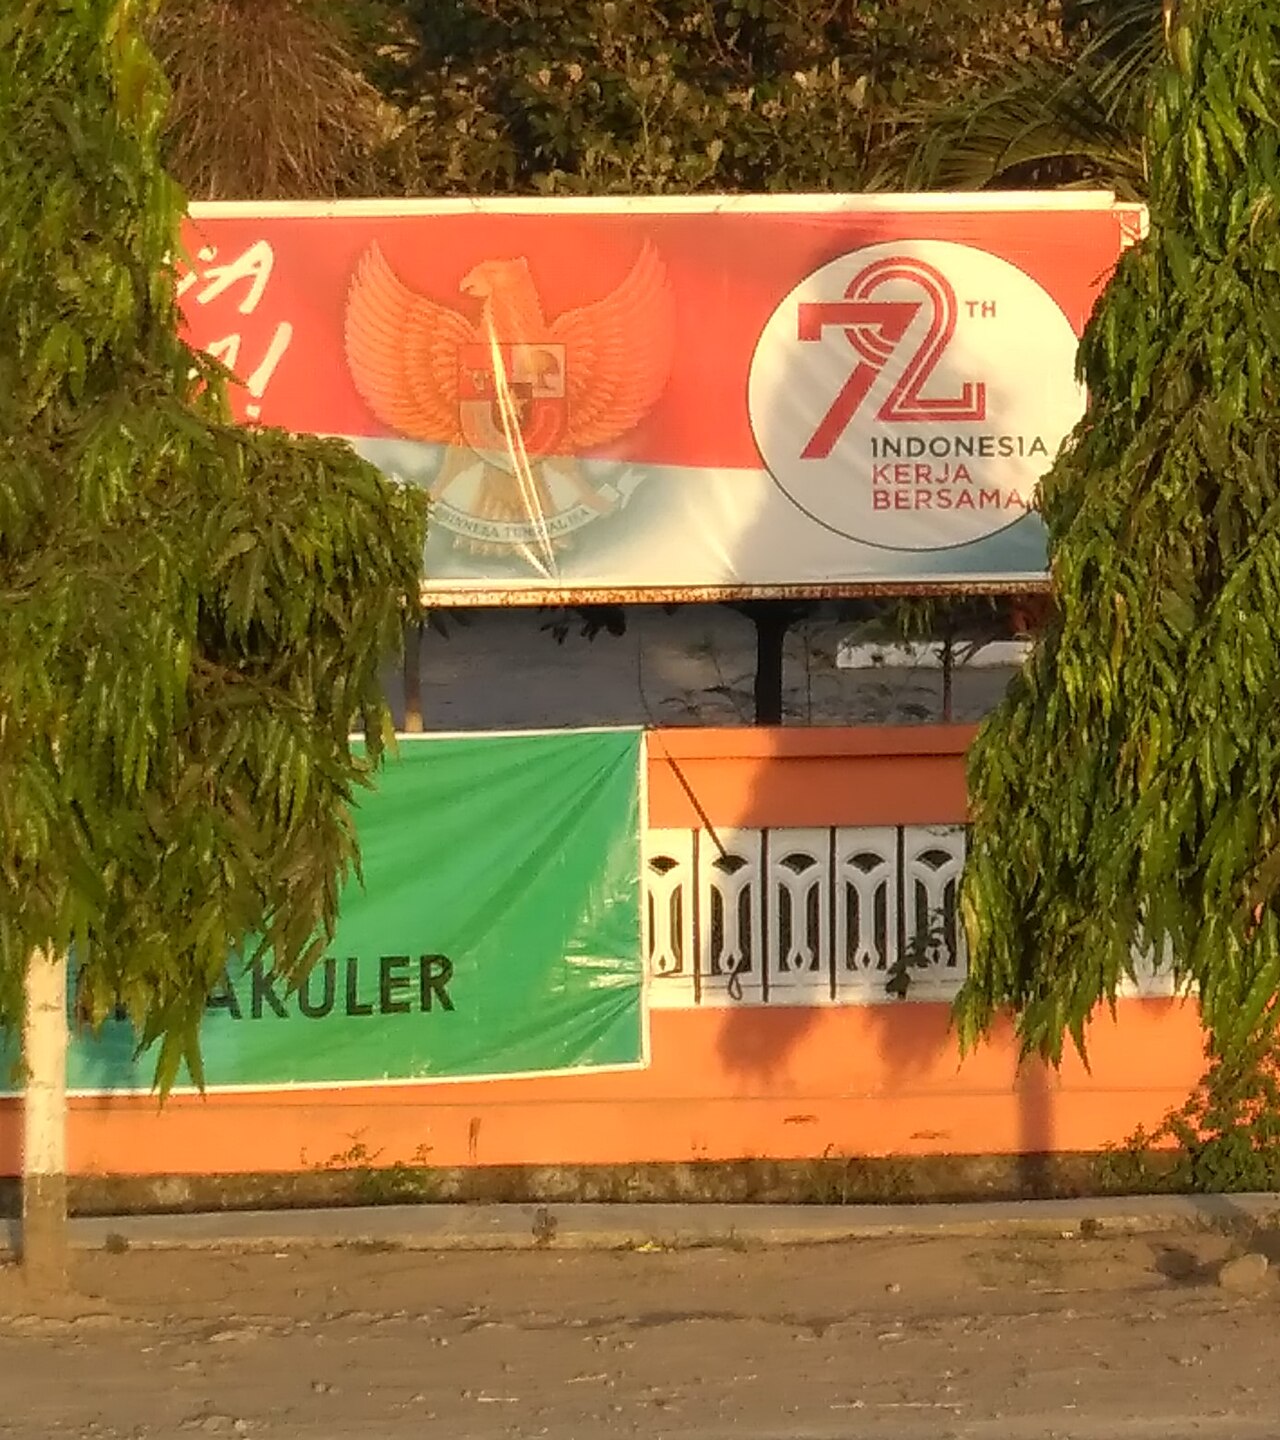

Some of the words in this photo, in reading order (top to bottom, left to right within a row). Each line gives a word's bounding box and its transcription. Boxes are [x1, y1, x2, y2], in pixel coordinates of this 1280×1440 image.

[798, 256, 986, 459] 72
[966, 300, 996, 318] TH
[871, 435, 1048, 458] INDONESIA
[872, 462, 973, 485] KERJA
[872, 488, 1026, 510] BERSAMA
